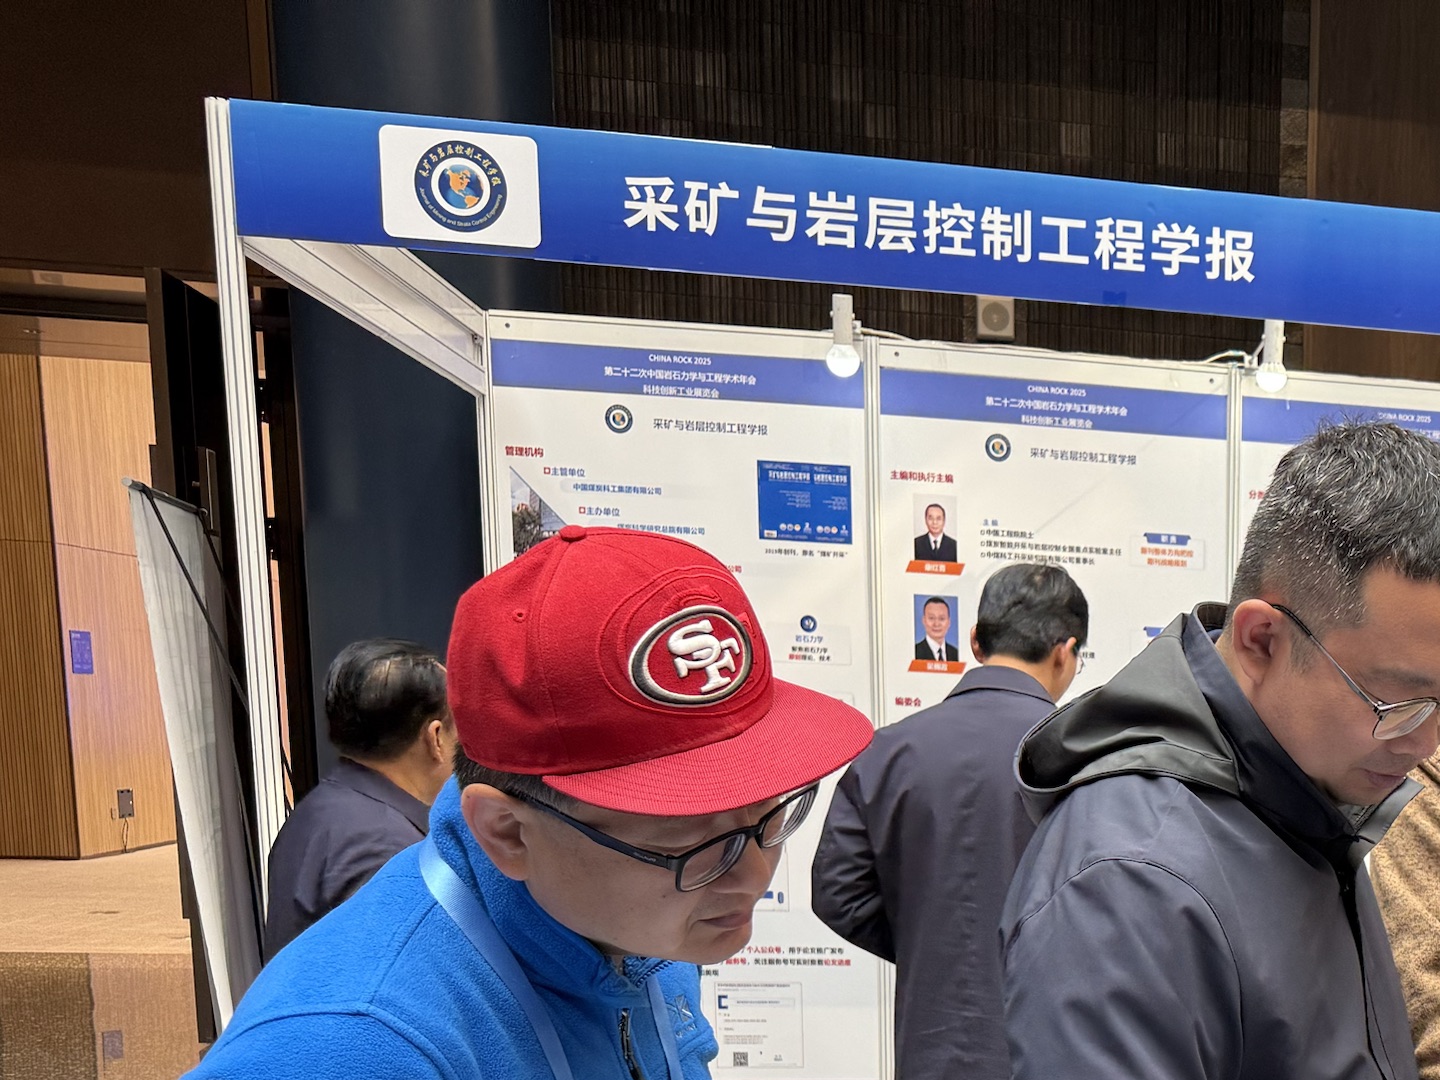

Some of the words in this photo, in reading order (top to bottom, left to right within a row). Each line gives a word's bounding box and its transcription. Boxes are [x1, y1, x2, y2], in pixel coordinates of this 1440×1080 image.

[623, 176, 1256, 284] 采矿与岩层控制工程学报
[648, 353, 672, 365] CHINA
[672, 355, 693, 366] ROCK
[693, 356, 712, 366] 2025
[604, 366, 757, 386] 第二十二次中国岩石力学与工程学术年会
[643, 384, 720, 399] 科技创新工业展览会
[1027, 384, 1050, 396] CHINA
[1050, 386, 1069, 397] ROCK
[1069, 388, 1087, 397] 2025
[985, 396, 1128, 417] 第二十二次中国岩石力学与工程学术年会
[1021, 414, 1093, 429] 科技创新工业展览会
[1399, 413, 1415, 424] ROCK
[1416, 415, 1432, 424] 2025
[653, 418, 768, 436] 采矿与岩层控制工程学报
[505, 445, 544, 458] 管理机构
[1030, 447, 1137, 466] 采矿与岩层控制工程学报
[551, 466, 586, 478] 主管单位
[890, 469, 954, 484] 主编和执行主编
[586, 506, 621, 518] 主办单位
